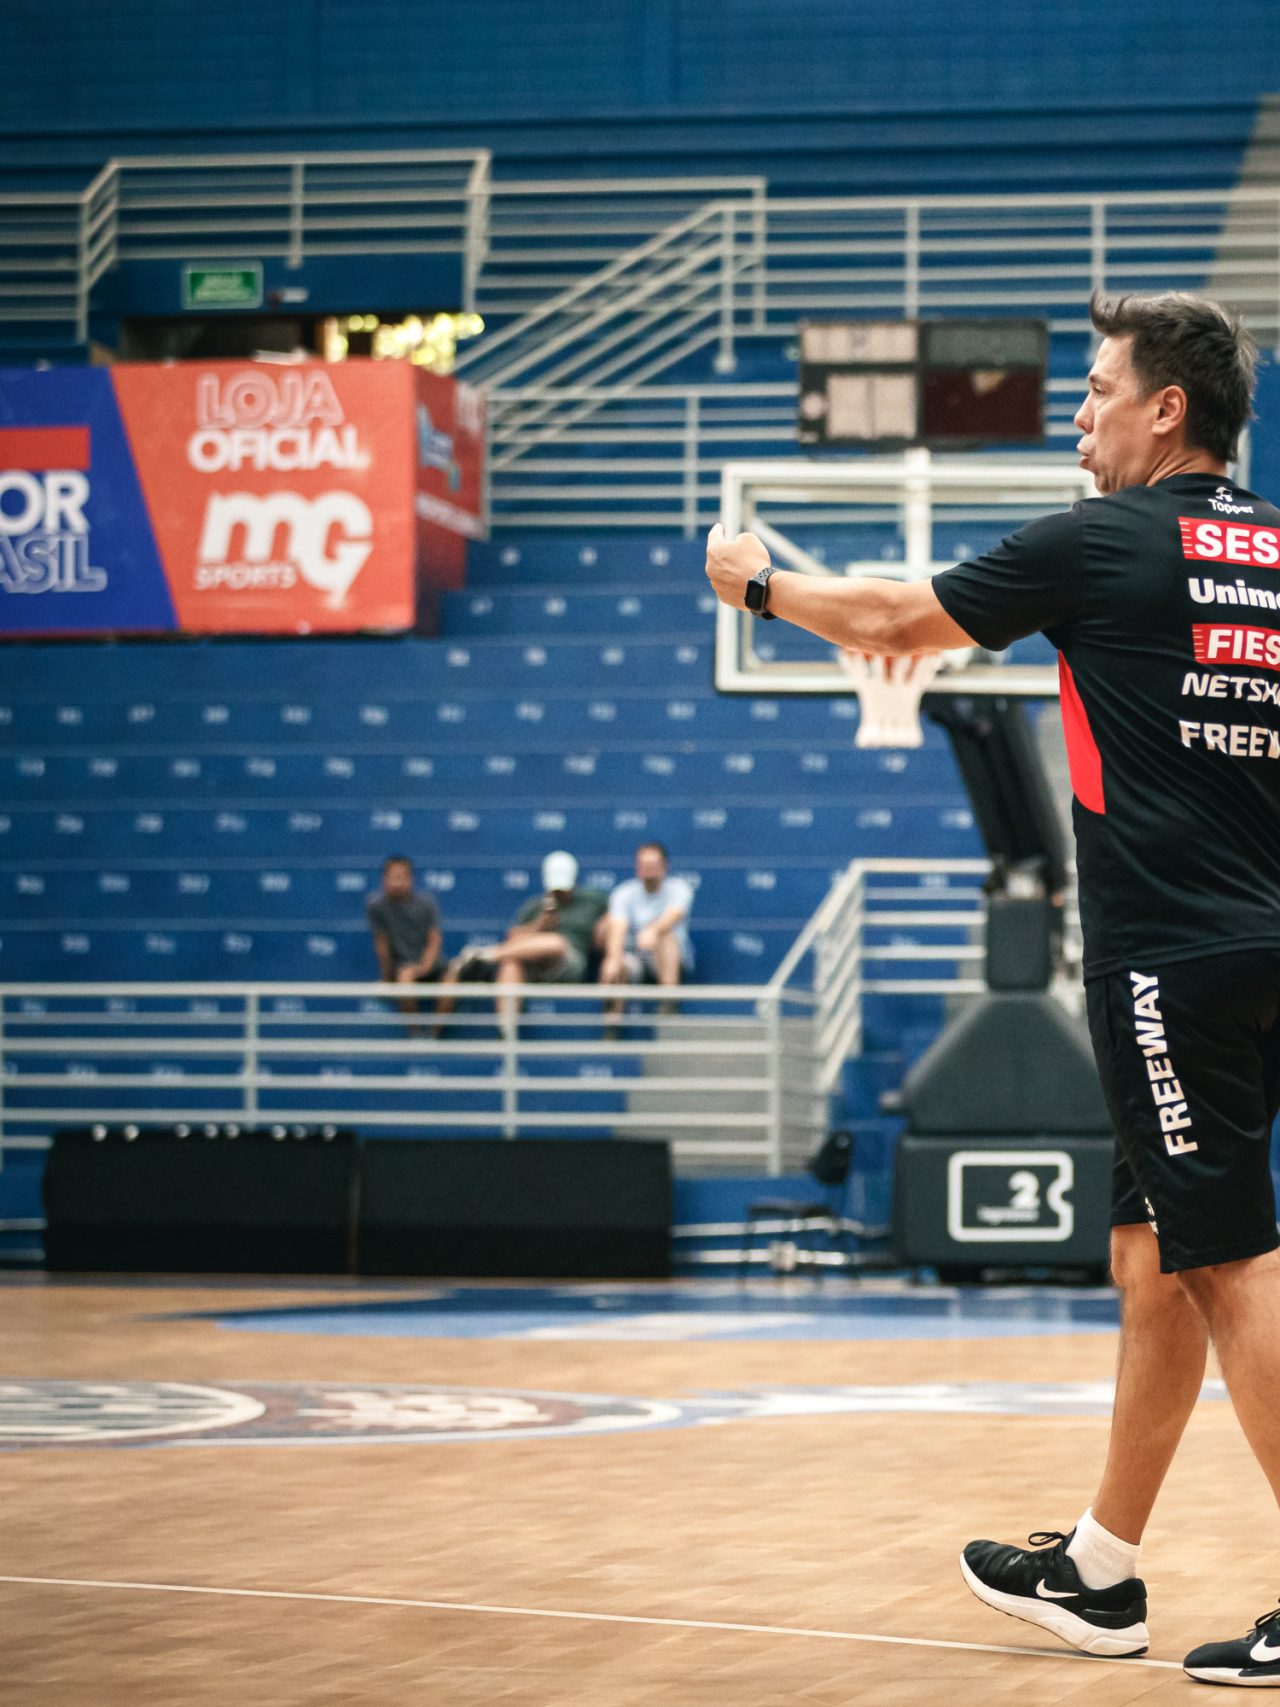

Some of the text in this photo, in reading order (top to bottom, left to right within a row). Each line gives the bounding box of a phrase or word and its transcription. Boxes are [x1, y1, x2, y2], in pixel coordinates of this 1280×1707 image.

[196, 370, 345, 429] LOJA
[188, 424, 371, 473] OFICIAL
[195, 565, 297, 590] SPORTS
[1130, 971, 1199, 1156] FREEWAY
